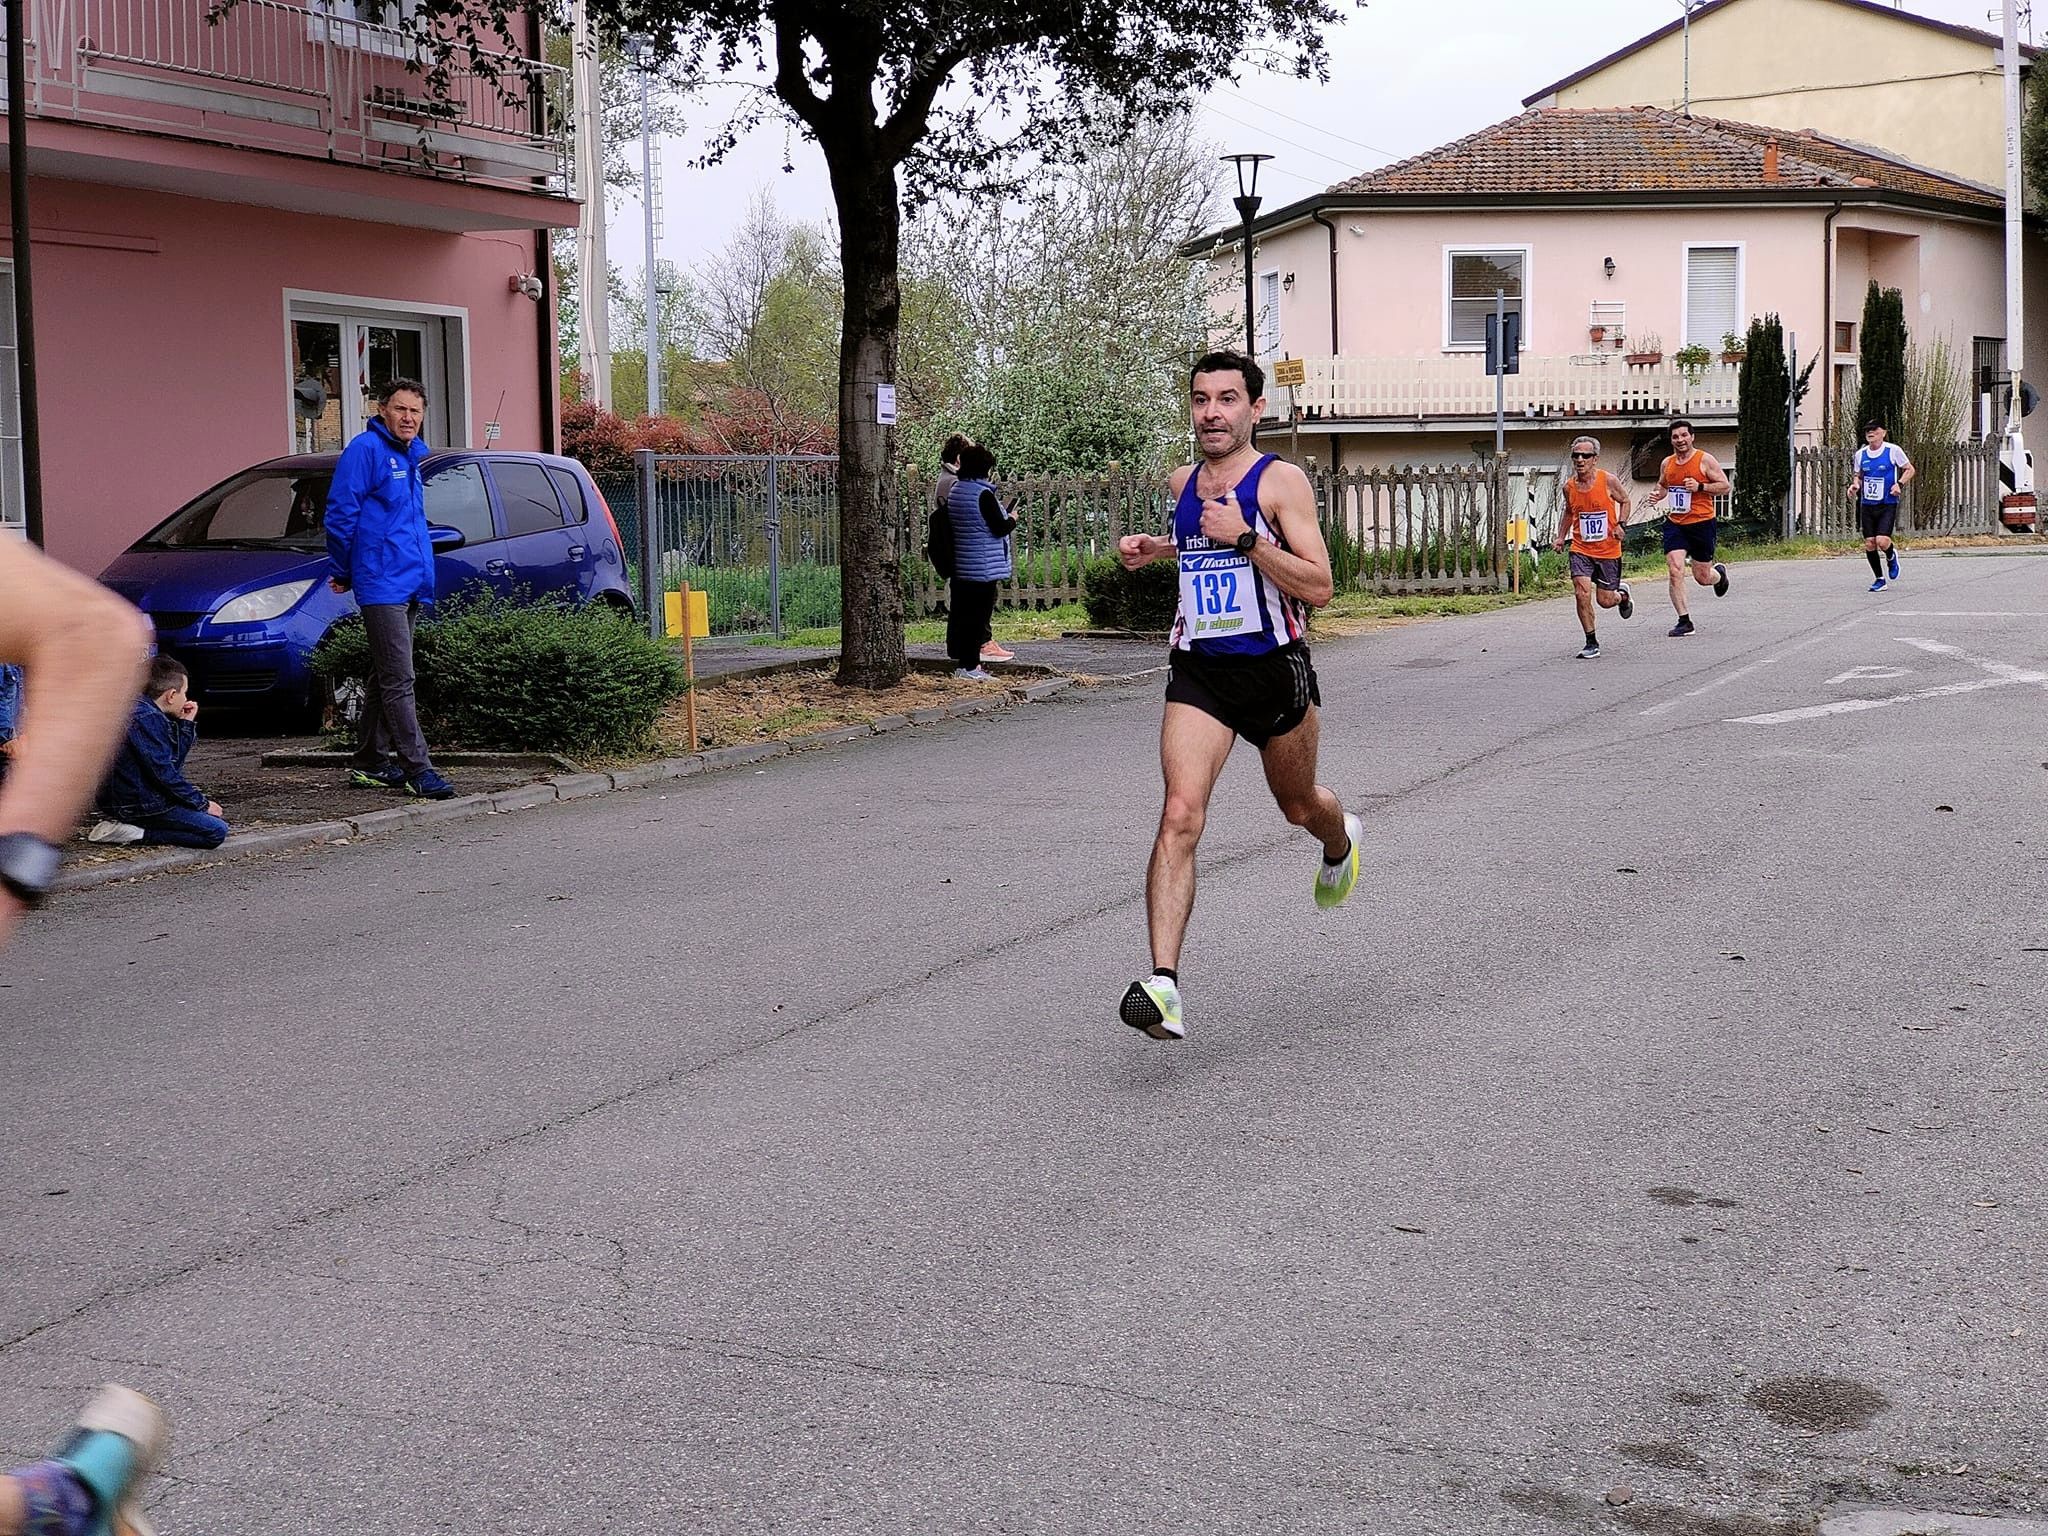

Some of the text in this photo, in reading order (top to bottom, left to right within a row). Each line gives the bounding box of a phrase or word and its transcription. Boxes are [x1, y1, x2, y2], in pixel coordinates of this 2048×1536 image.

[1868, 483, 1878, 494] 52
[1675, 493, 1684, 507] 16
[1585, 520, 1604, 534] 182
[1185, 535, 1209, 550] irish
[1192, 572, 1241, 615] 132
